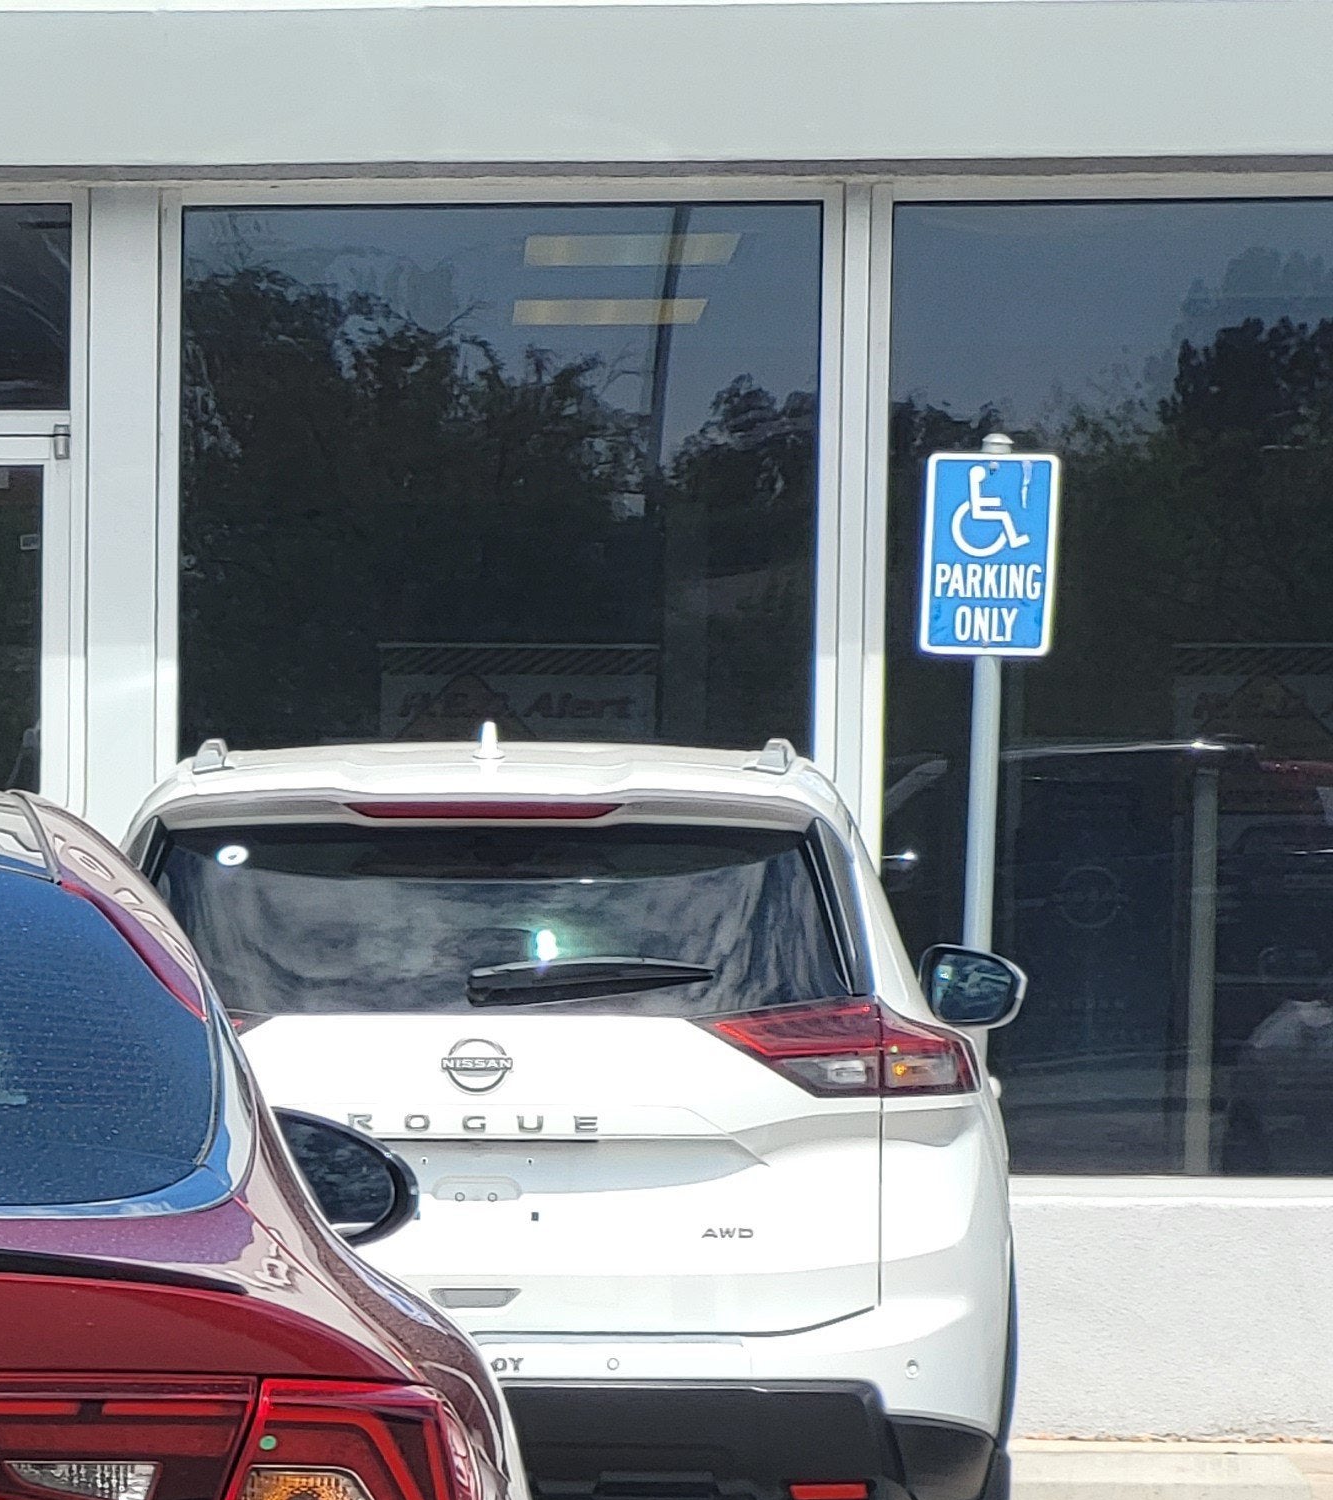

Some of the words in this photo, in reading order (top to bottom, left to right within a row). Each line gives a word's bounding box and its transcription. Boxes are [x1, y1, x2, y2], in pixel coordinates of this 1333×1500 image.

[934, 563, 1042, 600] PARKING
[954, 605, 1019, 643] ONLY
[442, 1058, 512, 1069] NISSAN
[347, 1113, 599, 1133] ROGUE
[701, 1227, 755, 1239] AWD
